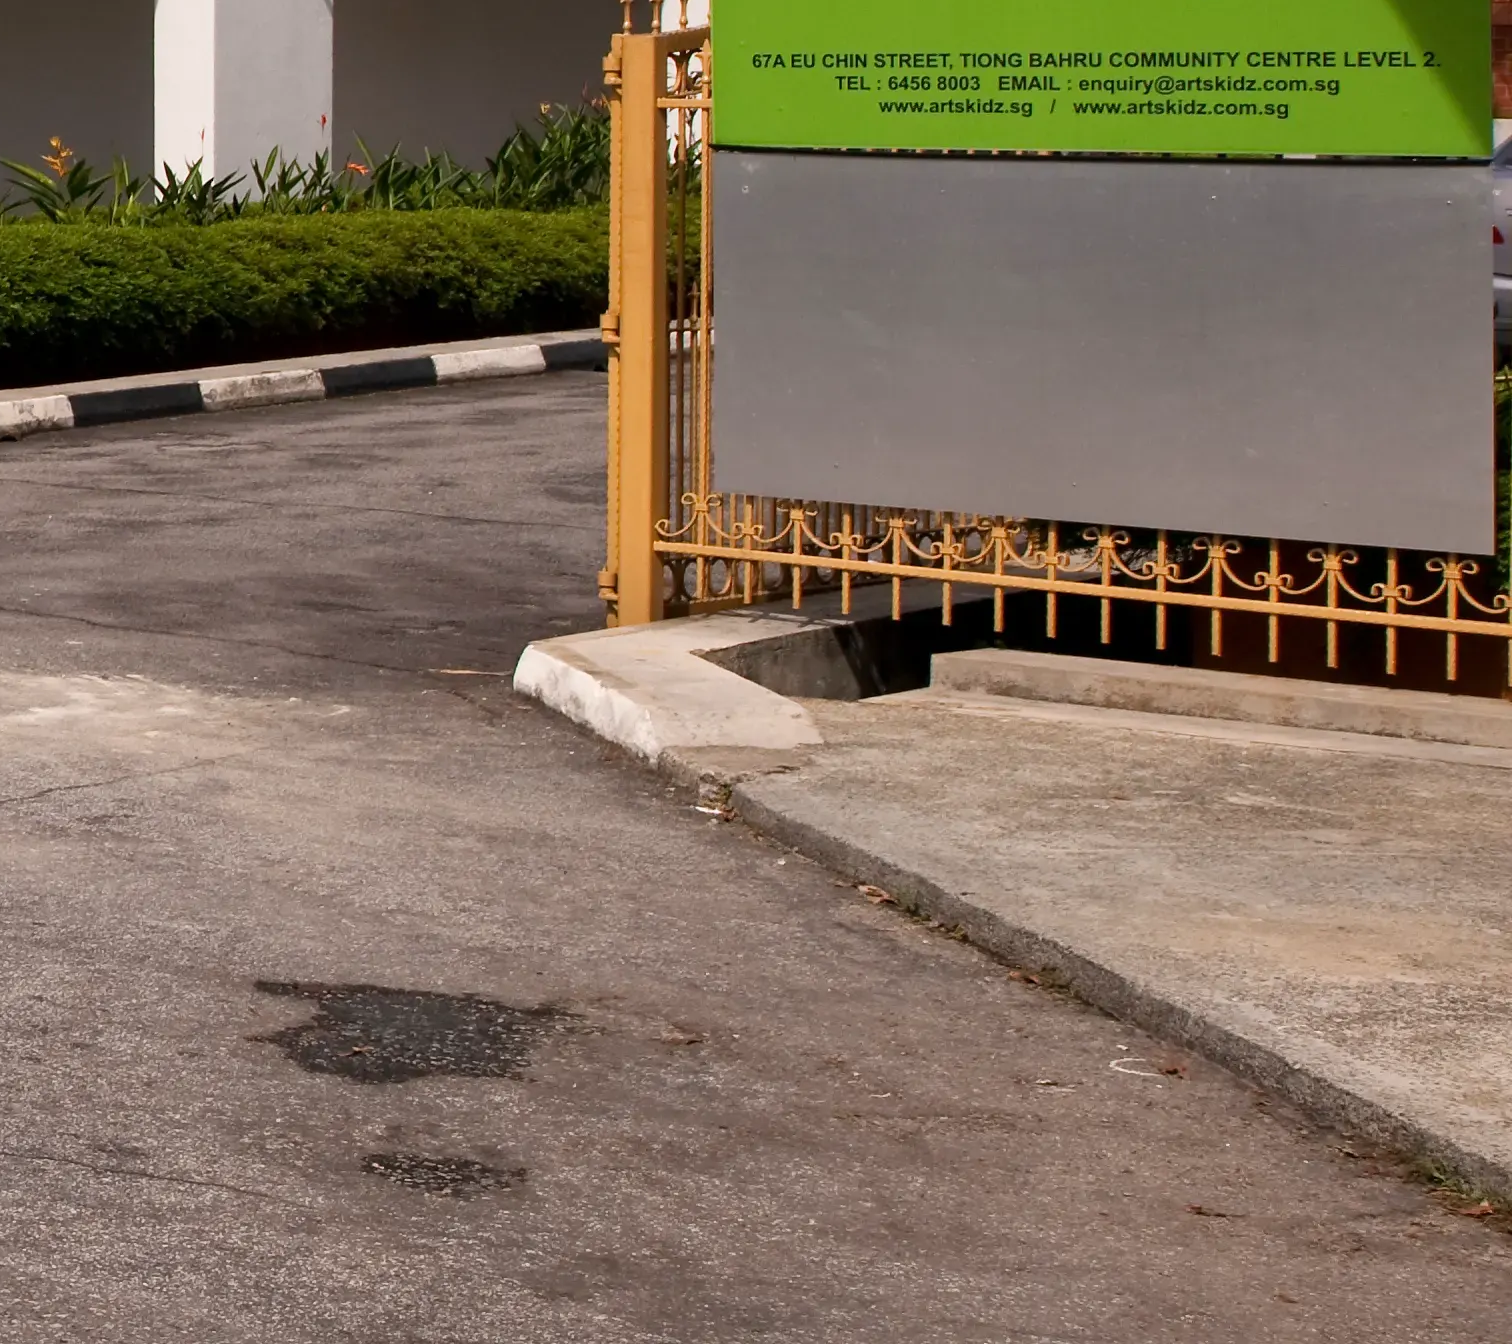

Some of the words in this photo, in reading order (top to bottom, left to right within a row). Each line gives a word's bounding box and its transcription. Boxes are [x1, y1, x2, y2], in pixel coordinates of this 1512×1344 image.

[752, 54, 786, 68] 67A
[791, 54, 815, 68] EU
[822, 53, 868, 68] CHIN
[874, 53, 954, 71] STREET,
[960, 53, 1022, 68] TIONG
[1029, 52, 1102, 68] BAHRU
[1109, 52, 1239, 68] COMMUNITY
[1246, 52, 1336, 67] CENTRE
[1344, 51, 1417, 67] LEVEL
[1422, 51, 1443, 68] 2.
[834, 76, 871, 91] TEL
[888, 76, 931, 91] 6456
[937, 75, 981, 91] 8003
[998, 75, 1061, 91] EMAIL
[1078, 74, 1341, 96] enquiry@artskidz.com.sg
[878, 99, 1034, 118] www.artskidz.sg
[1073, 99, 1290, 119] www.artskidz.com.sg
